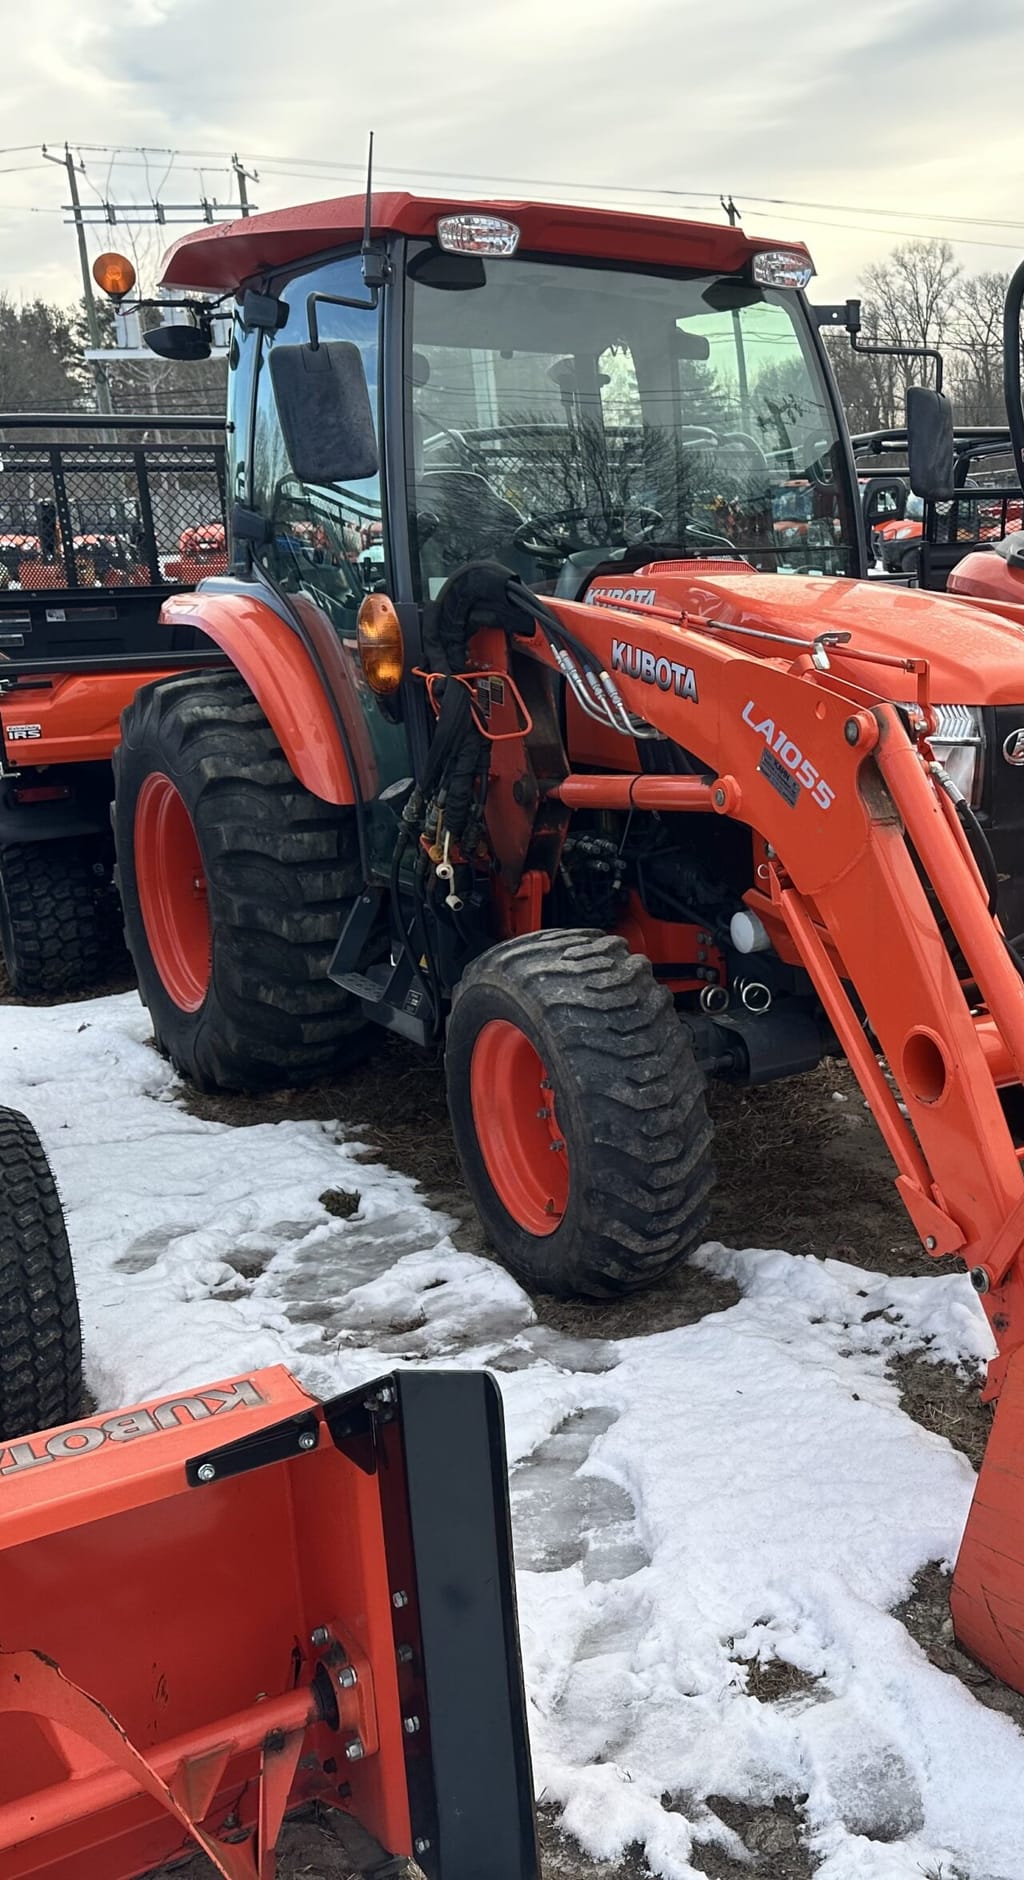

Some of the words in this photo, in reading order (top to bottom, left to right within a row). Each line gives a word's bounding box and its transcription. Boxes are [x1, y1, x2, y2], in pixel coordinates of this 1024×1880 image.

[611, 639, 699, 704] KUBOTA
[742, 701, 835, 810] LA1055
[0, 1379, 264, 1475] KUBOT
